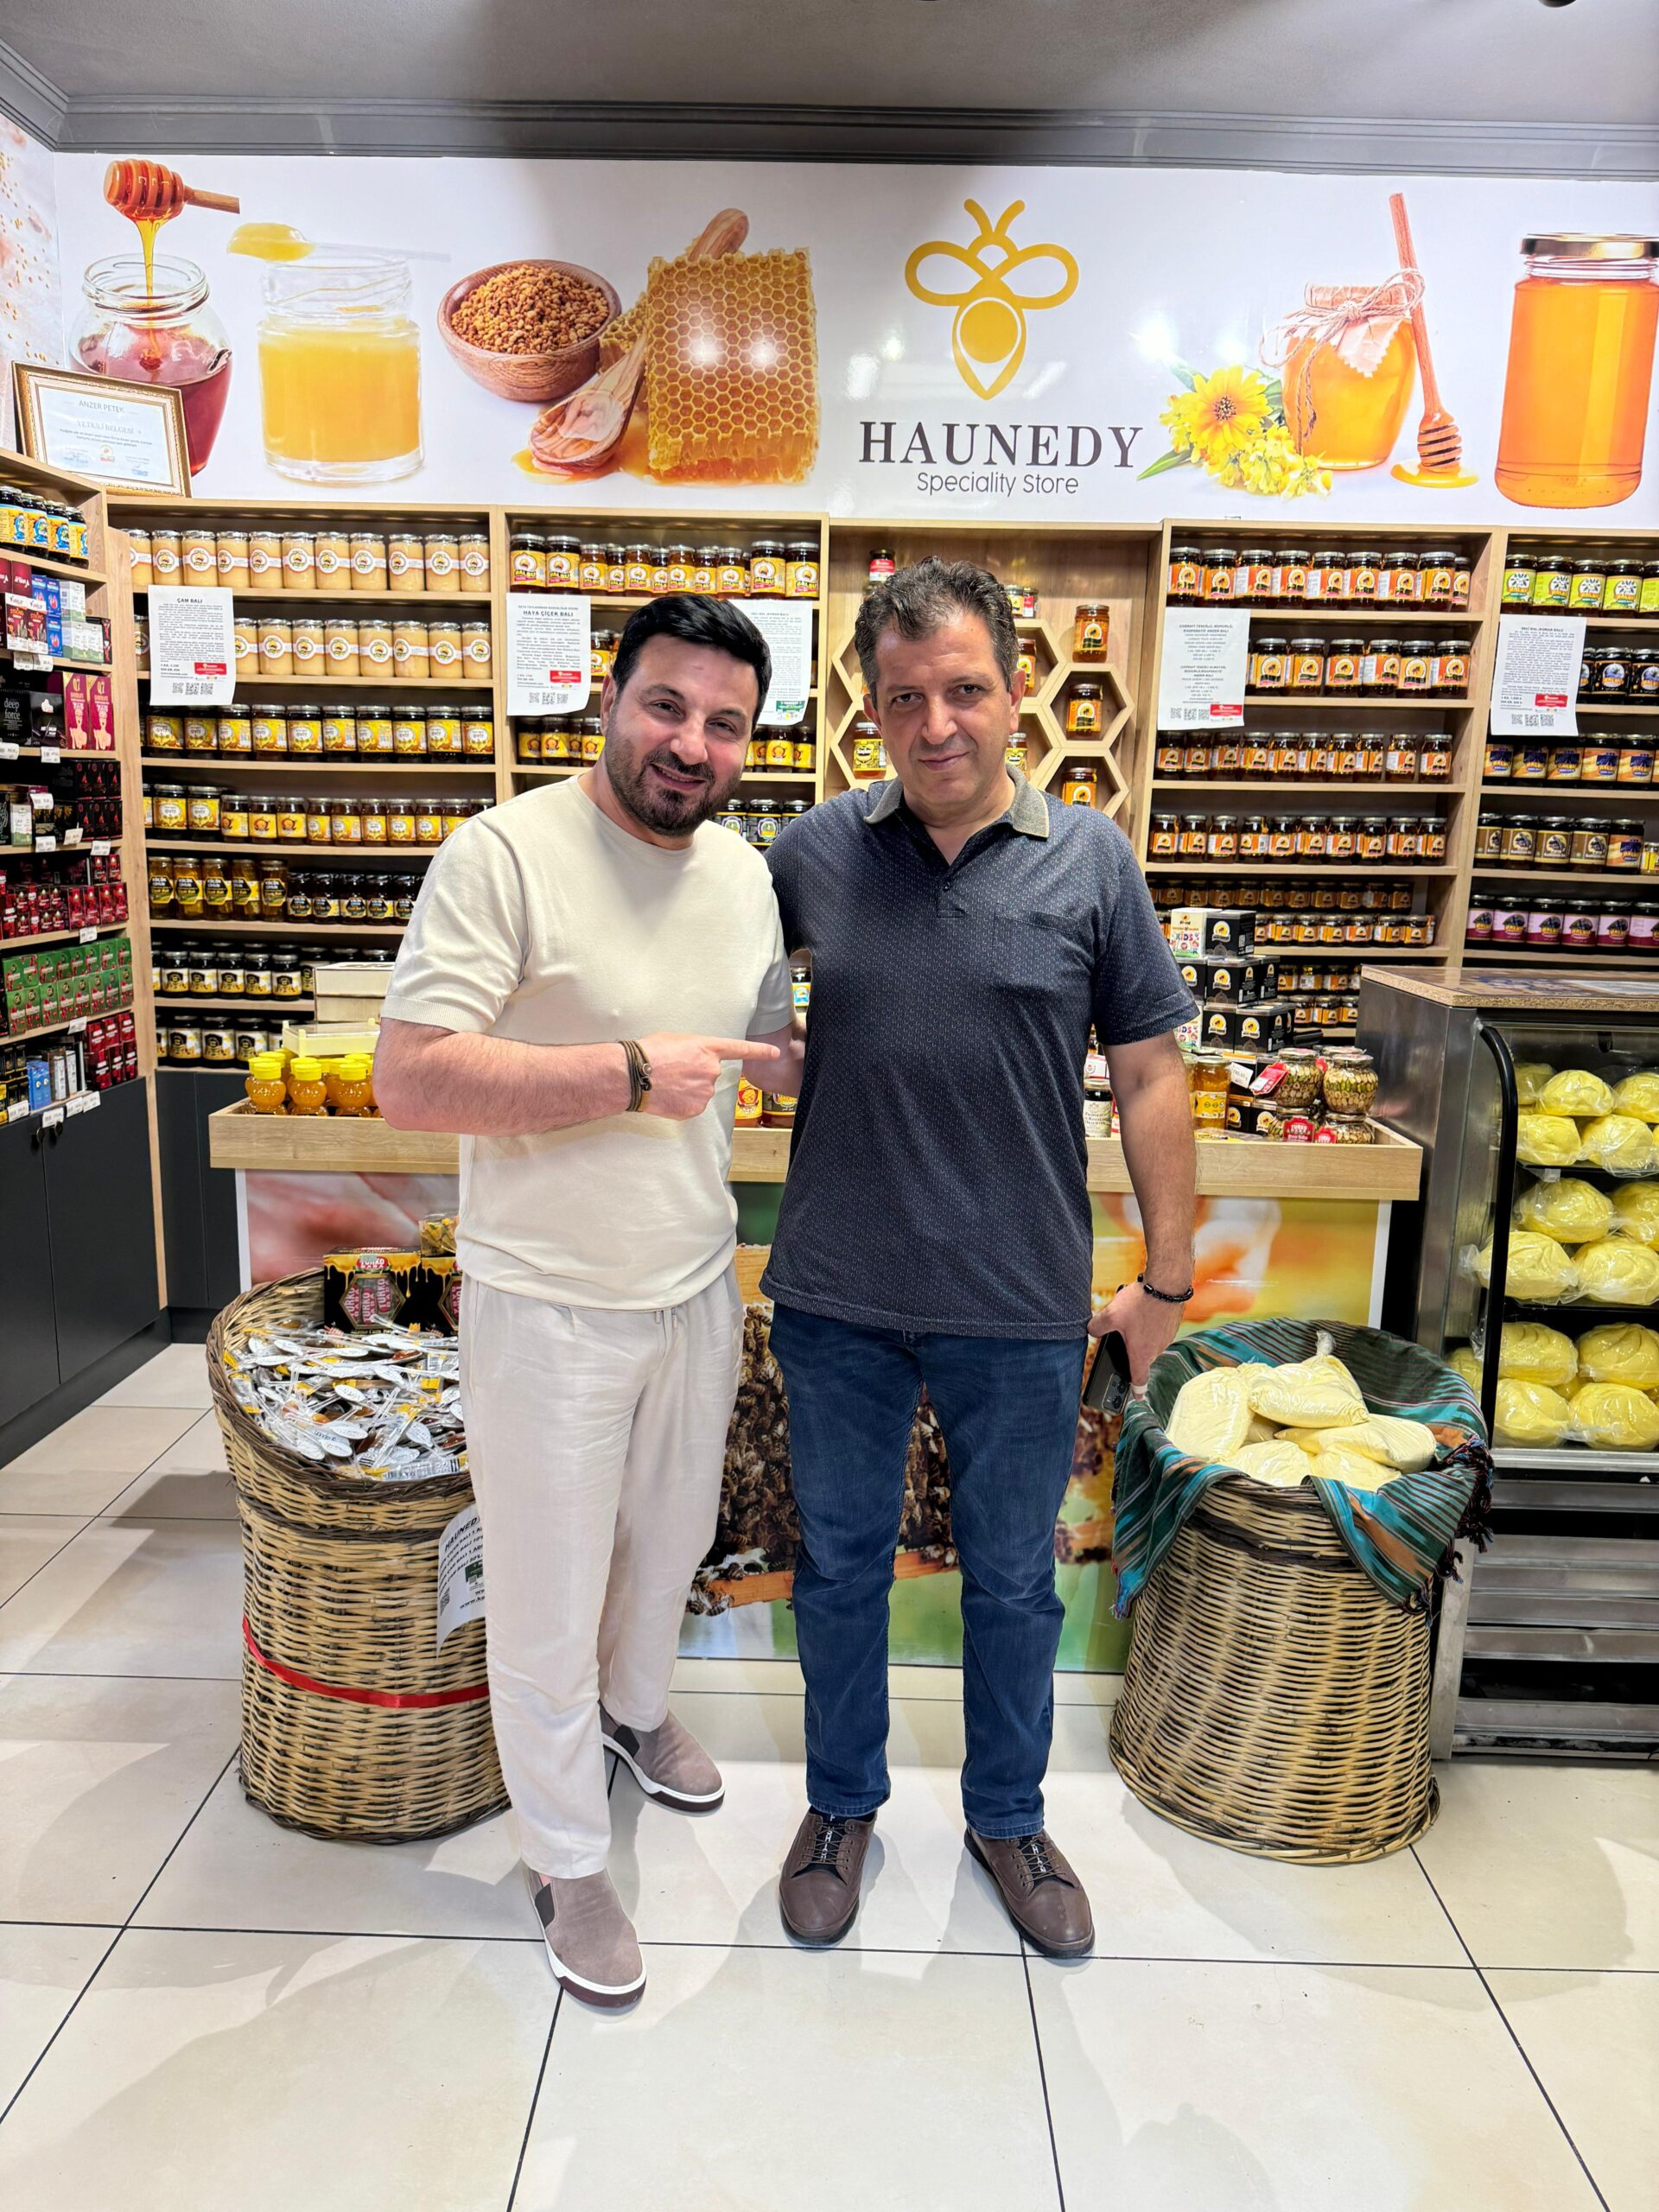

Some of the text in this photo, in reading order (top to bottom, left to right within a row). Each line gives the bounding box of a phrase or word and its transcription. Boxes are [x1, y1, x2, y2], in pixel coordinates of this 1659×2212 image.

[79, 400, 125, 413] ANZER PETEK
[859, 422, 1143, 467] HAUNEDY
[917, 472, 1079, 497] Speciality Store
[3, 698, 20, 710] deep
[4, 709, 21, 720] force
[363, 1293, 372, 1322] TURKO
